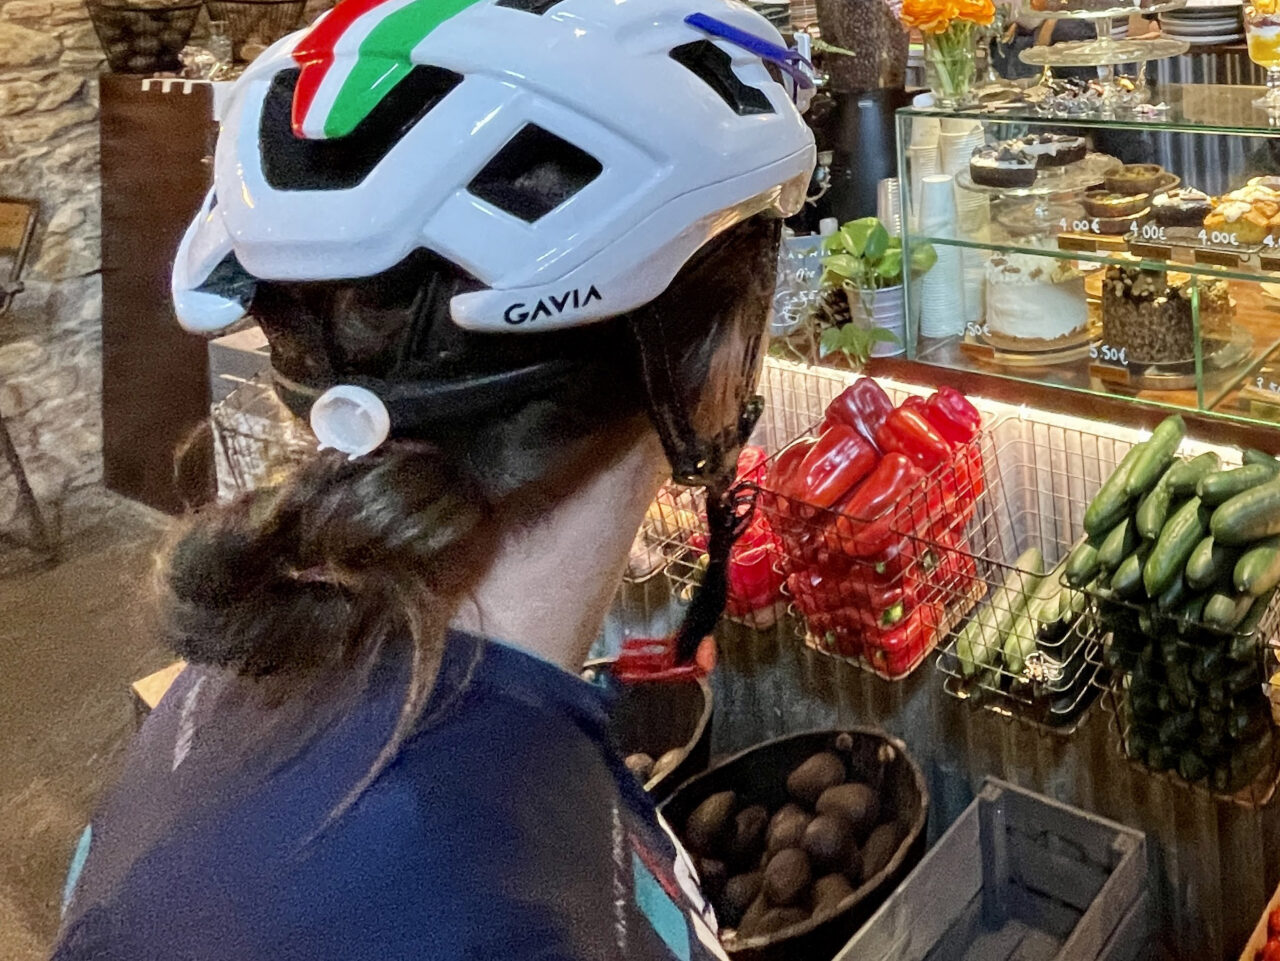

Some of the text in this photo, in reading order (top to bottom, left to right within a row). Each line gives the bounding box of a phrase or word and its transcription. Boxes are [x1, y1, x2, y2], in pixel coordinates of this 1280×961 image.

[1060, 218, 1100, 233] 4.00€
[1198, 229, 1239, 246] 4.00€
[504, 285, 602, 325] GAVIA
[1089, 343, 1129, 365] 5.50€
